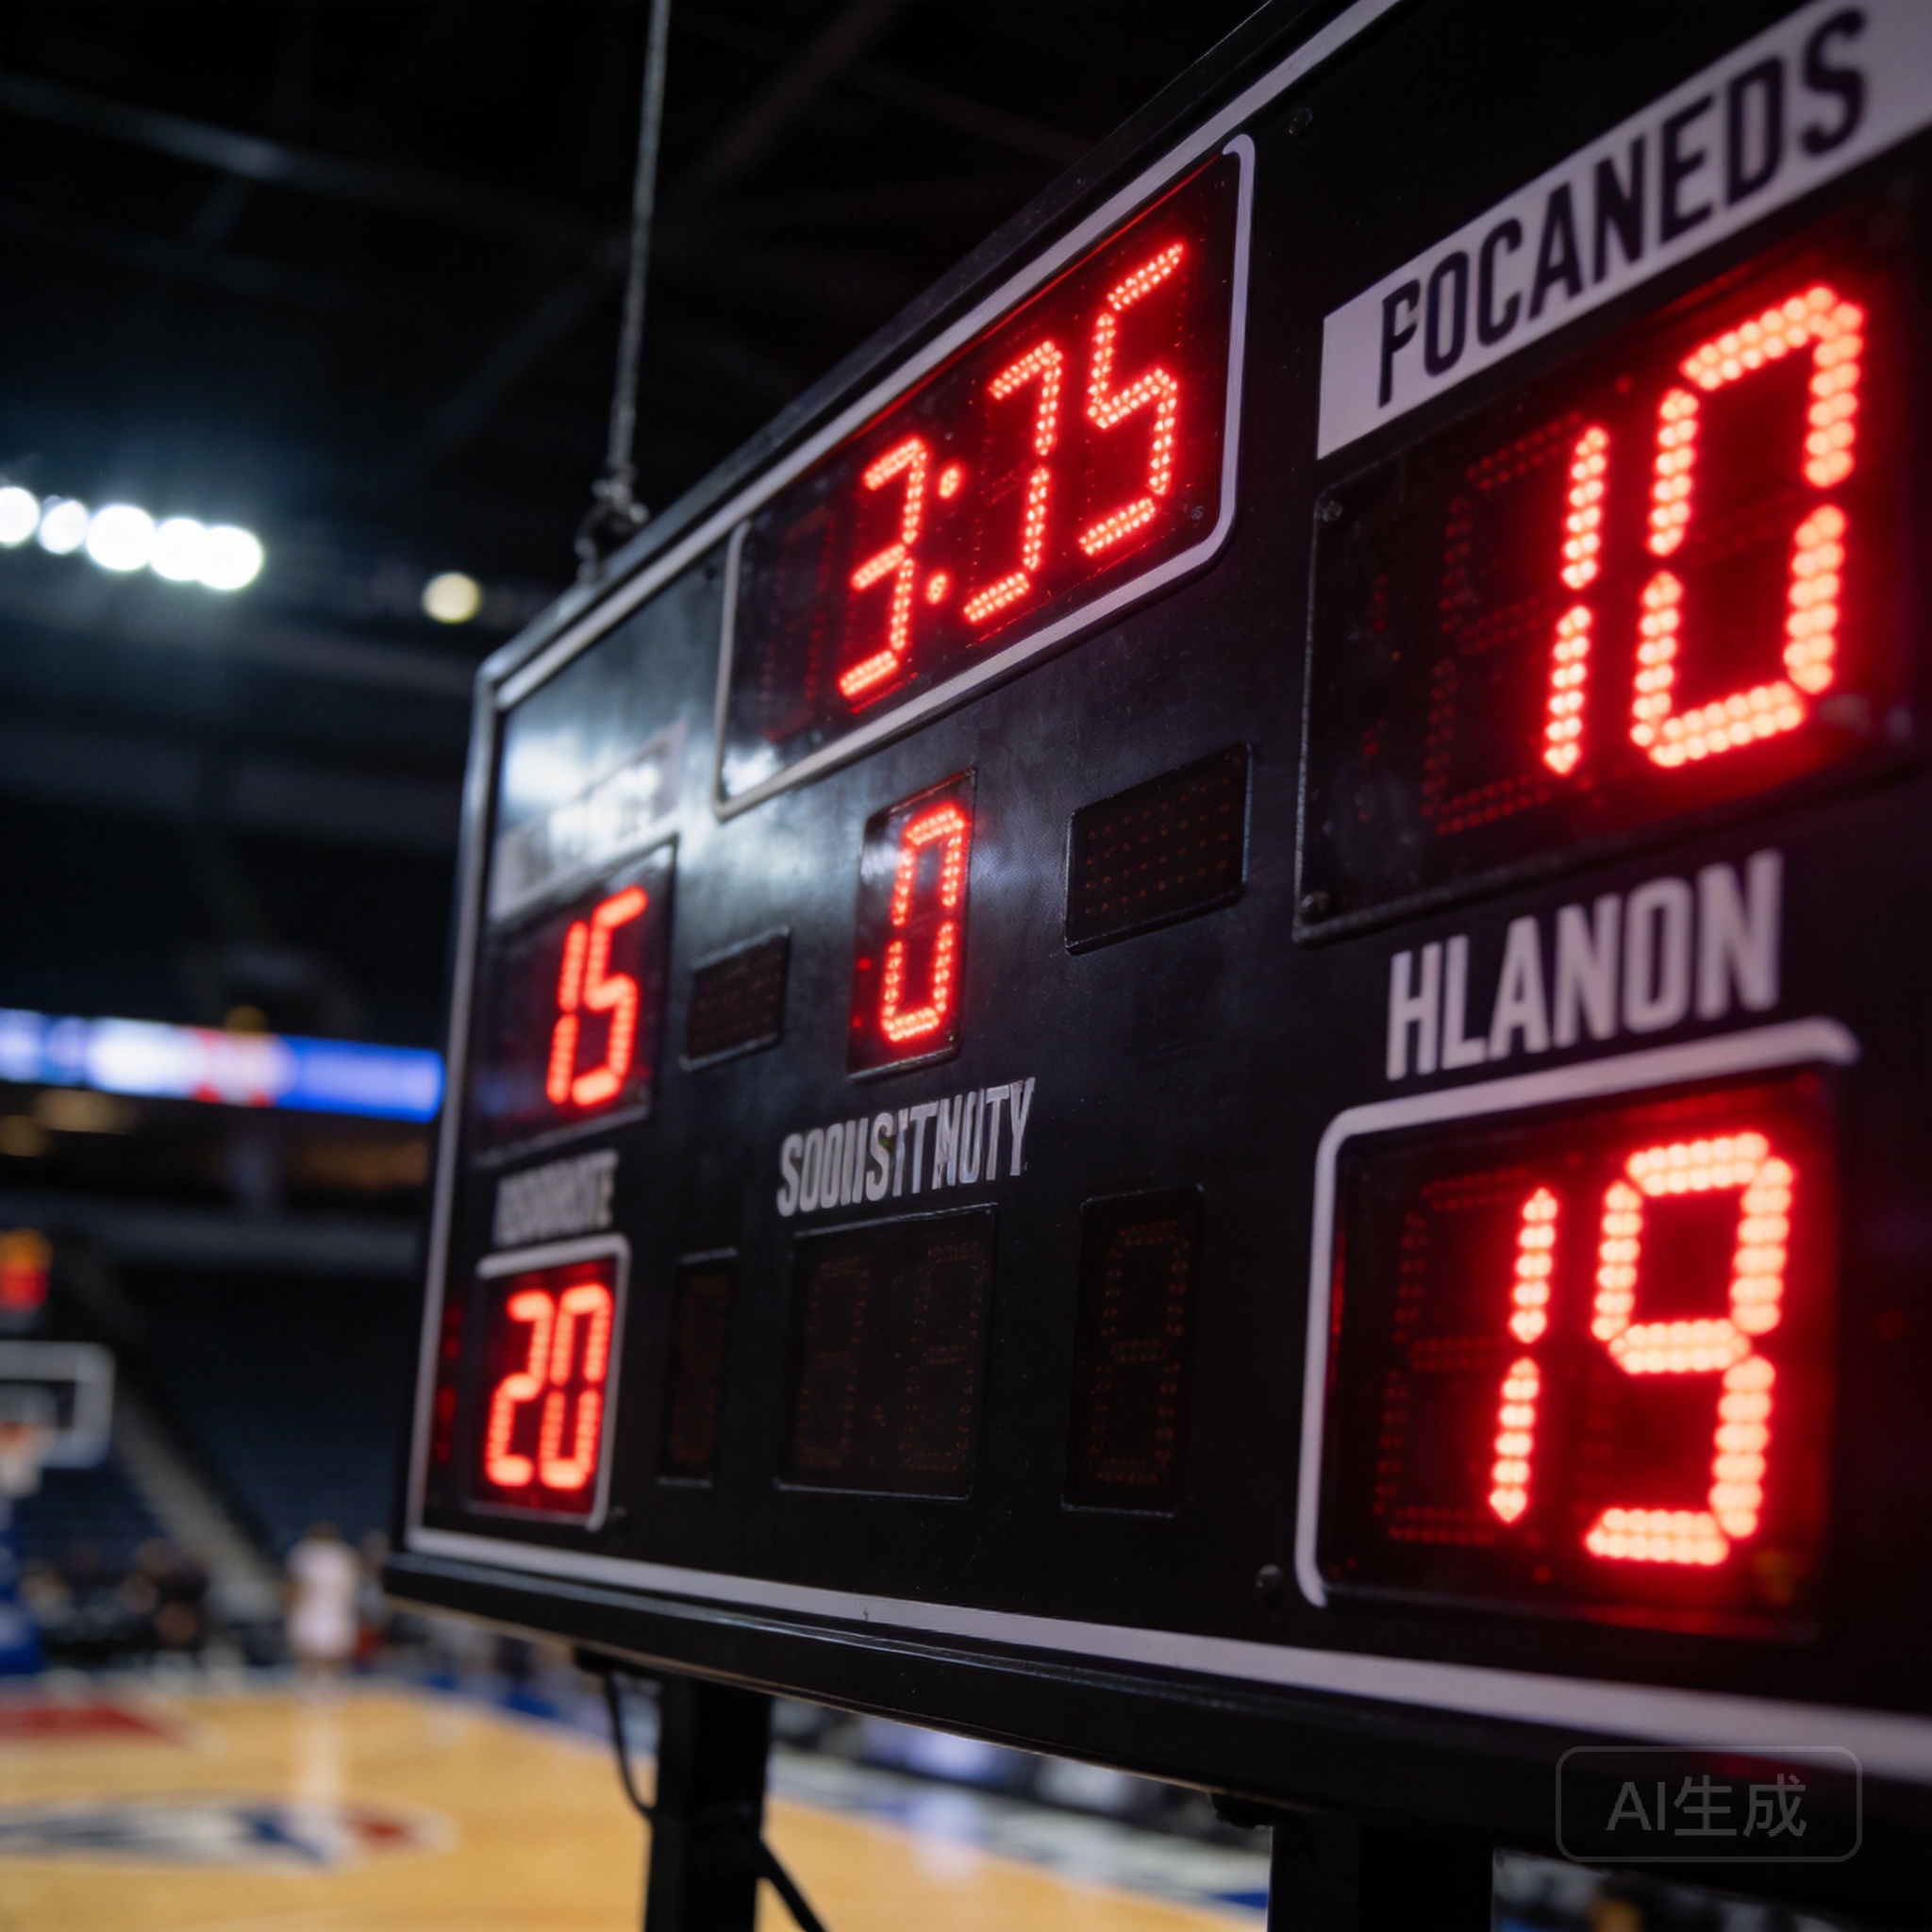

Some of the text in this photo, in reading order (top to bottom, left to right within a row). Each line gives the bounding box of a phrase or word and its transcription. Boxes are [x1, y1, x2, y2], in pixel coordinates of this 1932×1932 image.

[1541, 282, 1865, 777] 10
[546, 885, 649, 1108] 15
[1385, 848, 1784, 1081] HLANON
[485, 1282, 614, 1491] 20
[1487, 1129, 1796, 1568] 19
